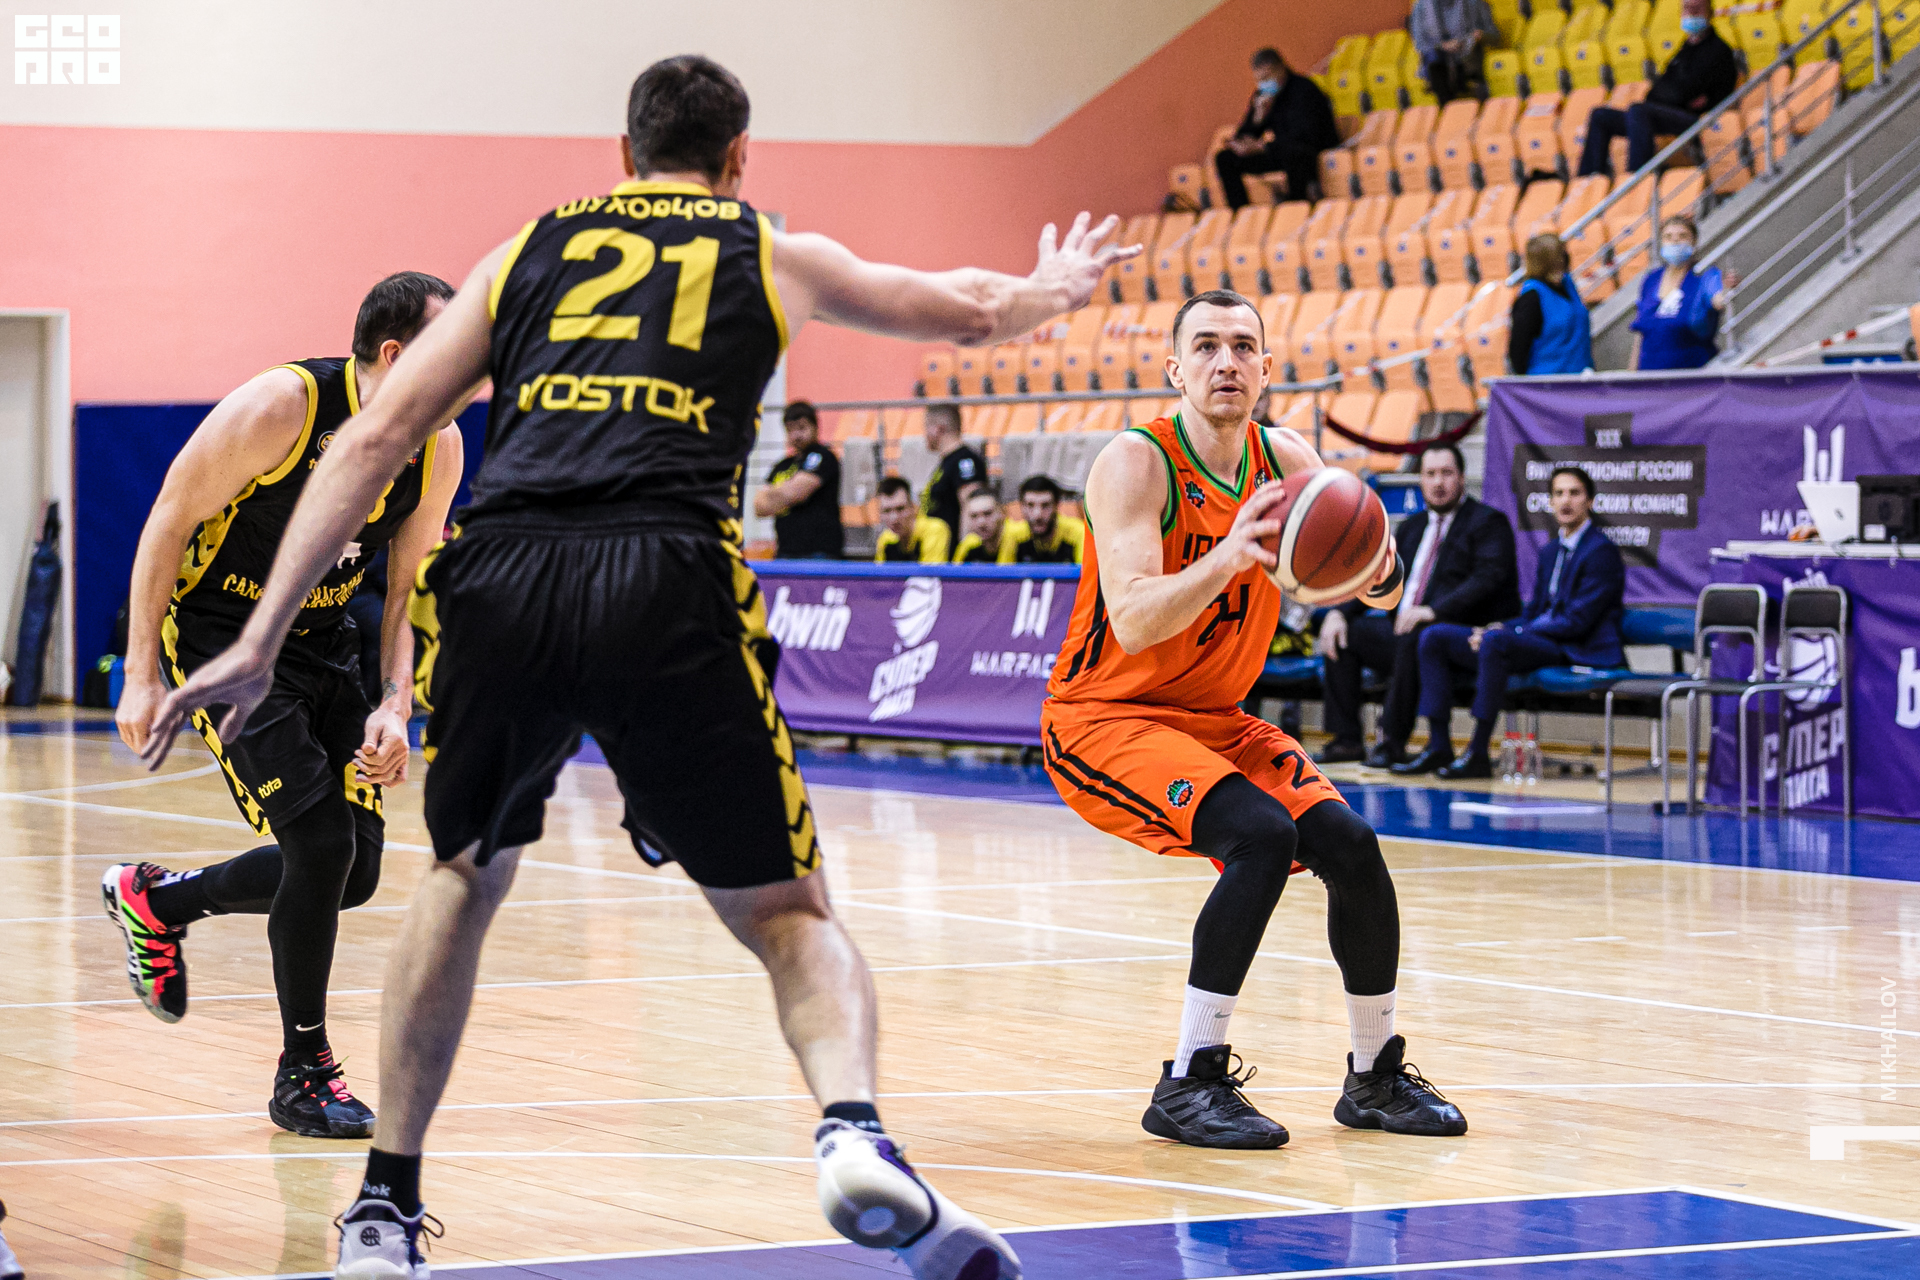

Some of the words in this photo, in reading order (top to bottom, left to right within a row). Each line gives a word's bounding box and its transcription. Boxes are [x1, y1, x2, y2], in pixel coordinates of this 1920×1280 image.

[548, 226, 720, 352] 21
[517, 373, 716, 434] VOSTOK
[768, 585, 851, 651] bwin
[1196, 583, 1251, 648] 24
[969, 651, 1057, 679] WARFAC
